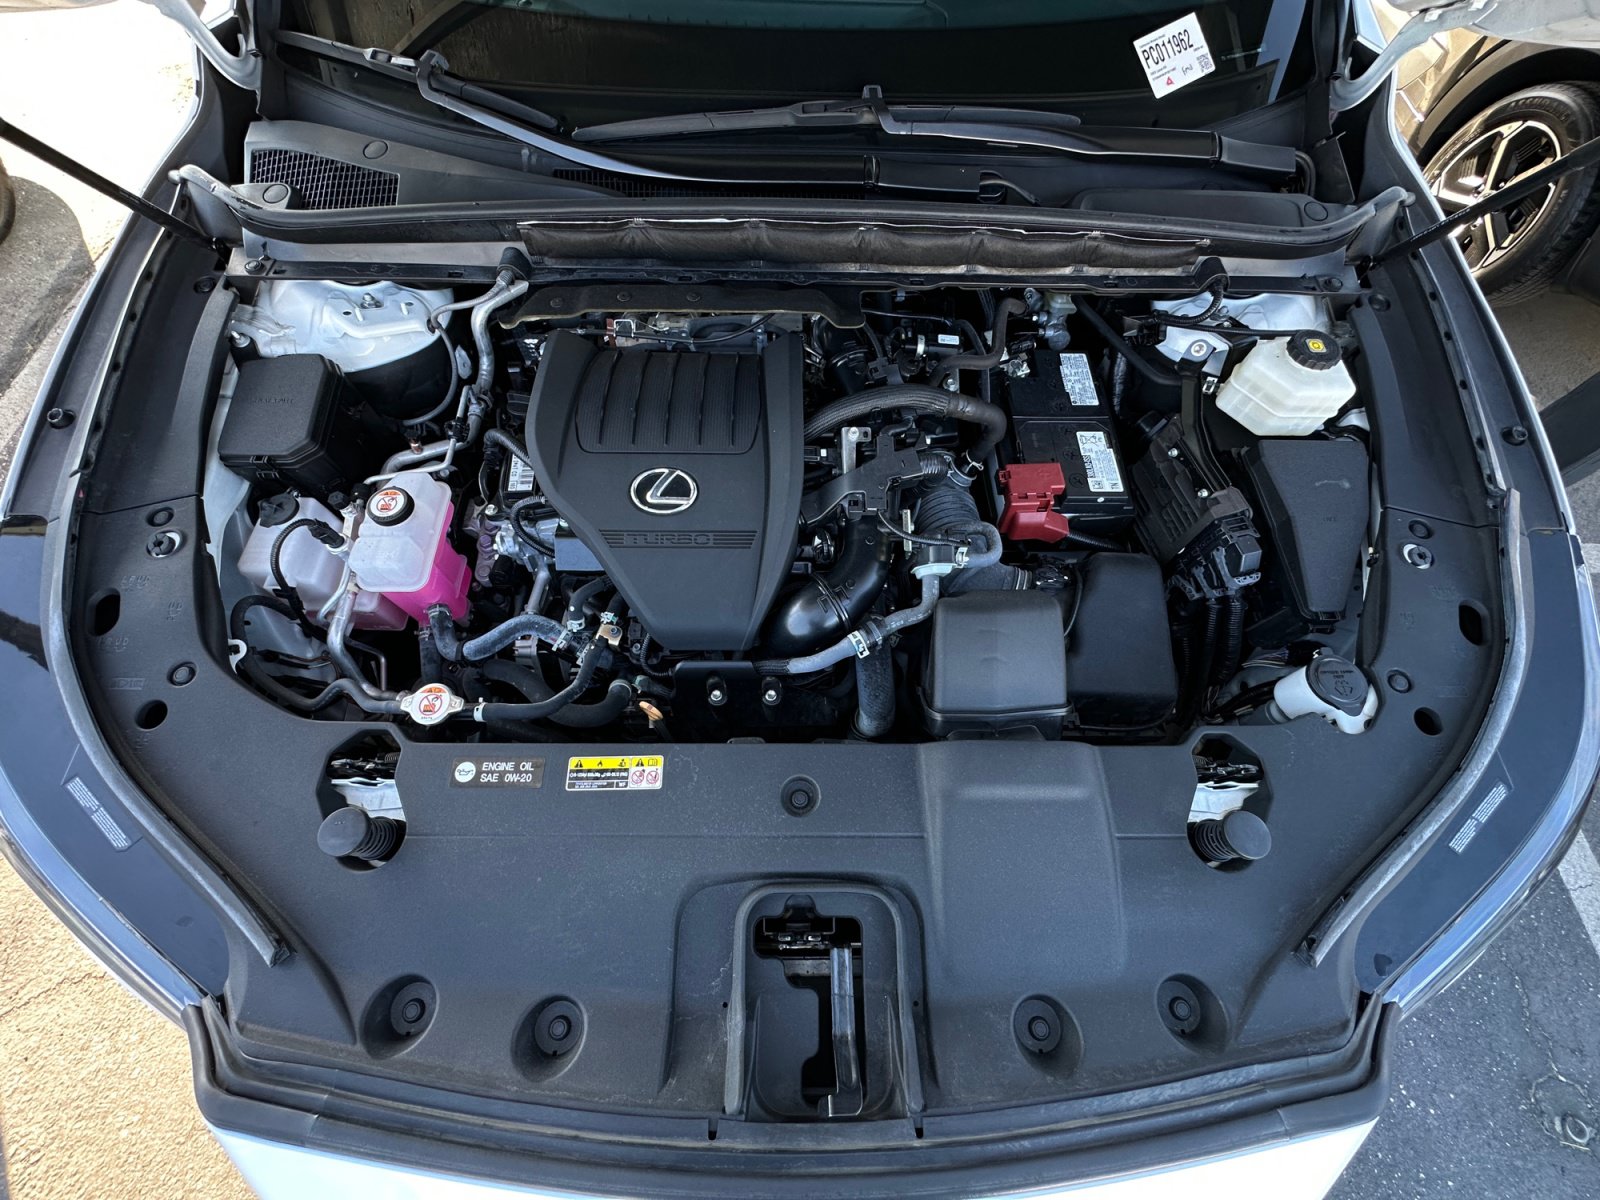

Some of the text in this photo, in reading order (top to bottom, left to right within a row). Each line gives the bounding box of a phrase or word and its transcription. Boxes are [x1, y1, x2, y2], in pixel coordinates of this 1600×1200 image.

[1142, 29, 1193, 69] PC011962
[626, 533, 711, 545] TURBO
[482, 762, 534, 771] ENGINE OIL
[480, 773, 532, 782] SAE 0W-20
